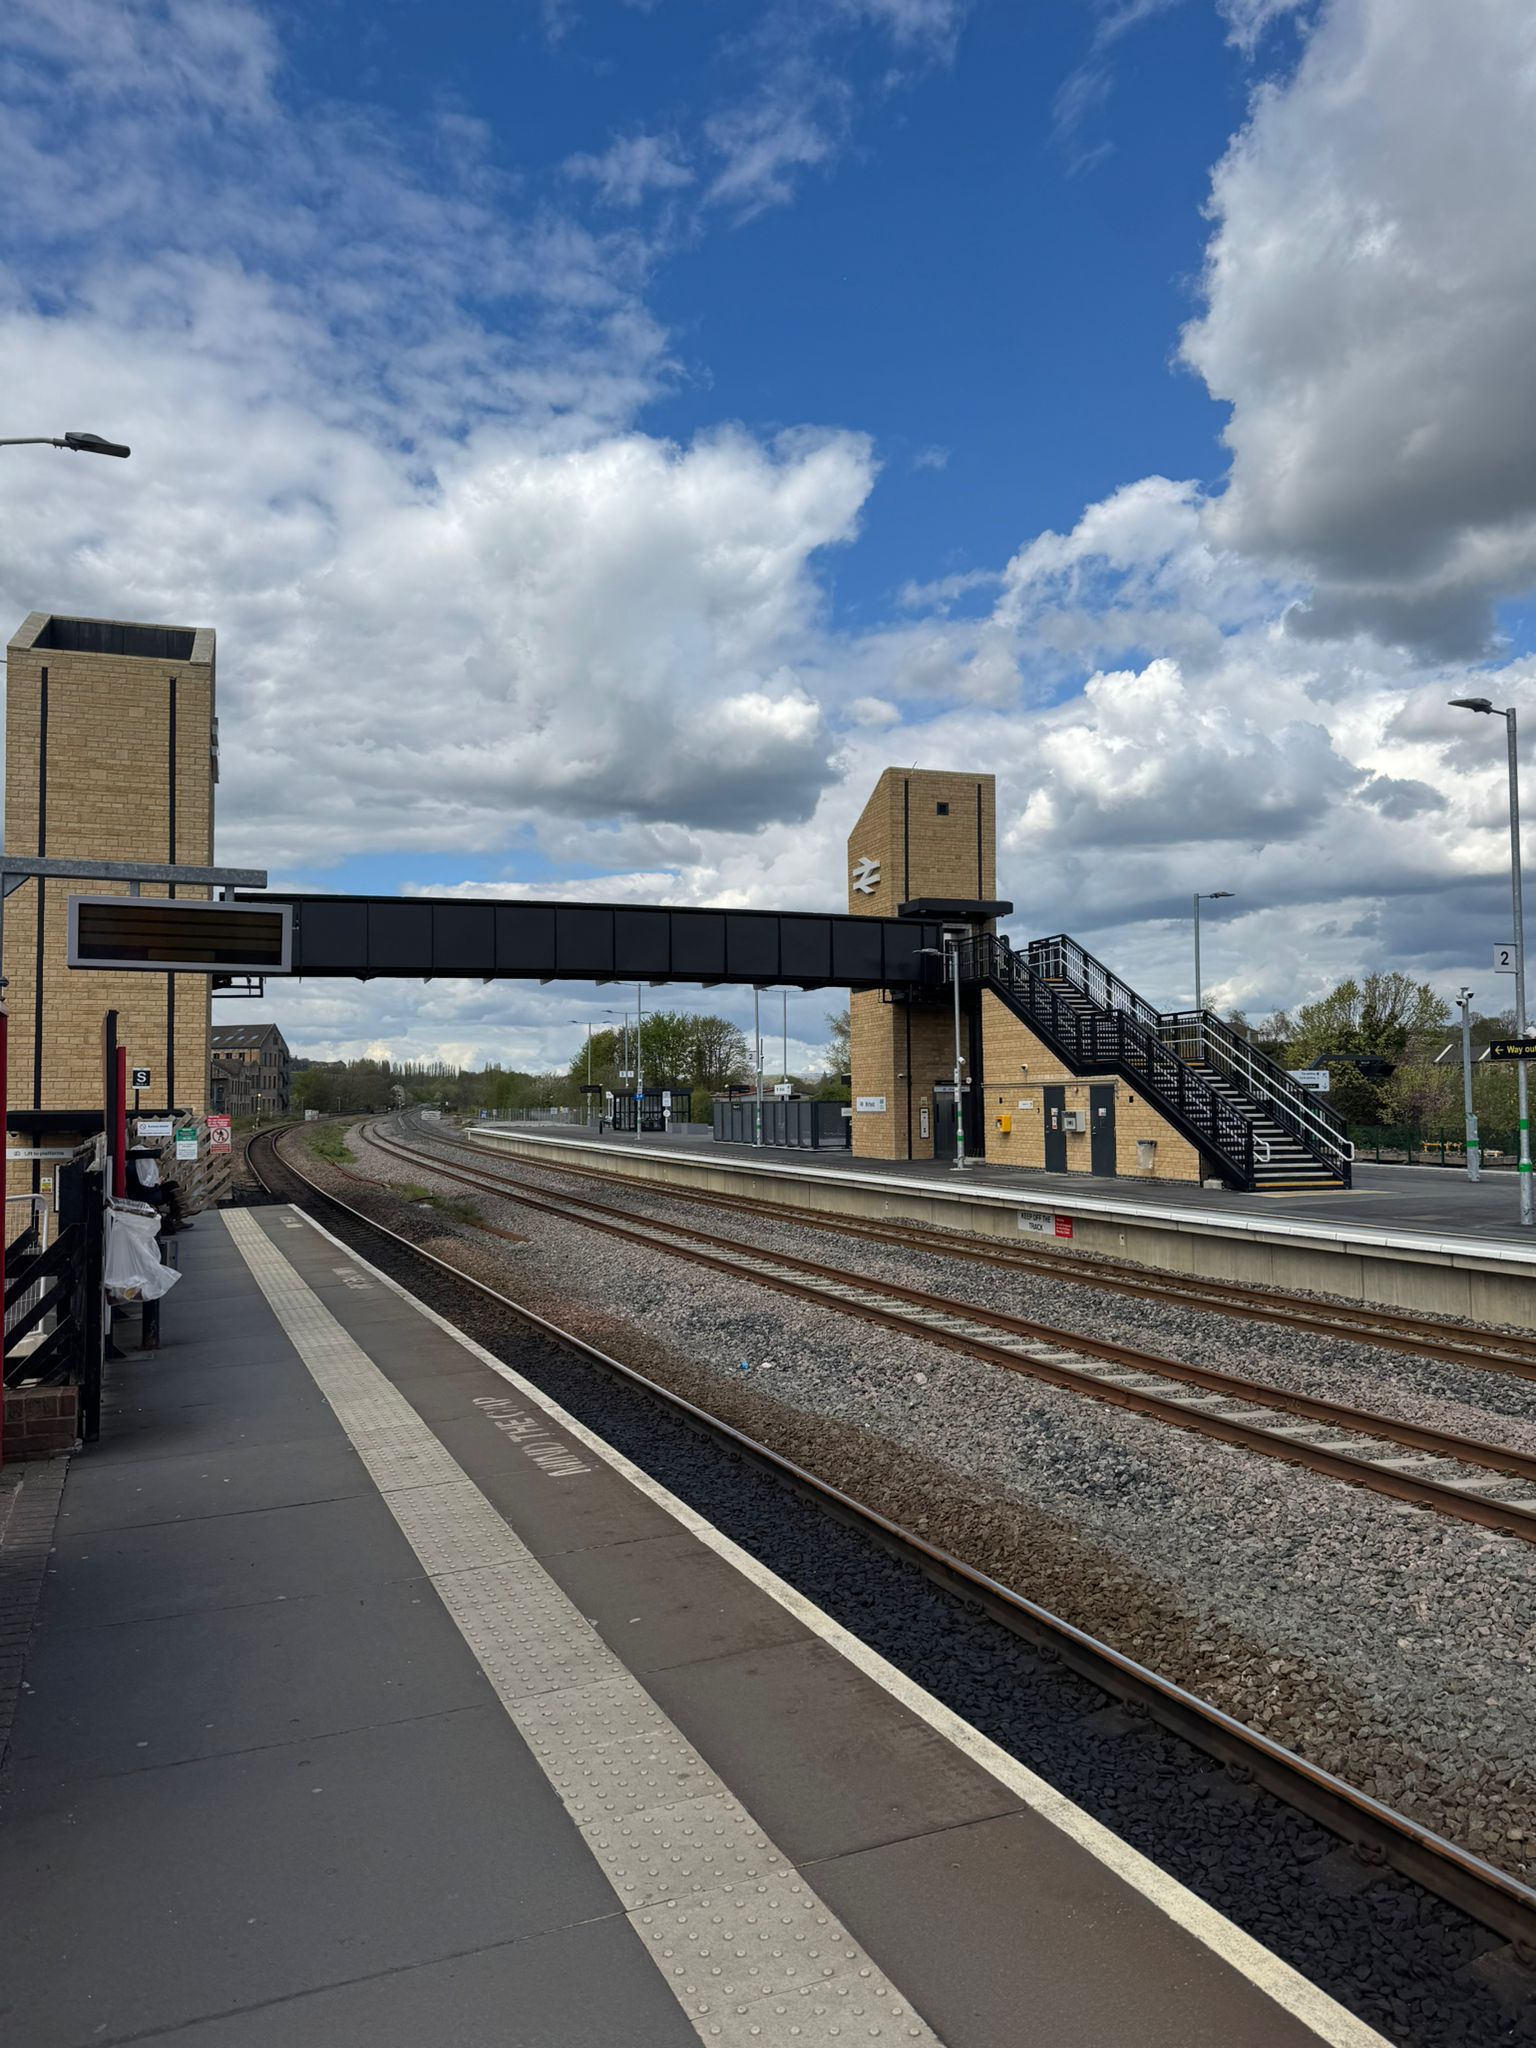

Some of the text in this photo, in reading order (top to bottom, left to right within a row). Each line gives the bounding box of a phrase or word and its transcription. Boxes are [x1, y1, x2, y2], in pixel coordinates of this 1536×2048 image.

[1500, 951, 1509, 966] 2
[1506, 1045, 1523, 1055] Way
[136, 1071, 147, 1083] S
[1021, 1212, 1051, 1223] KEEP OFF THE
[1029, 1222, 1043, 1231] TRACK
[494, 1417, 550, 1443] THE
[521, 1441, 592, 1477] MIND
